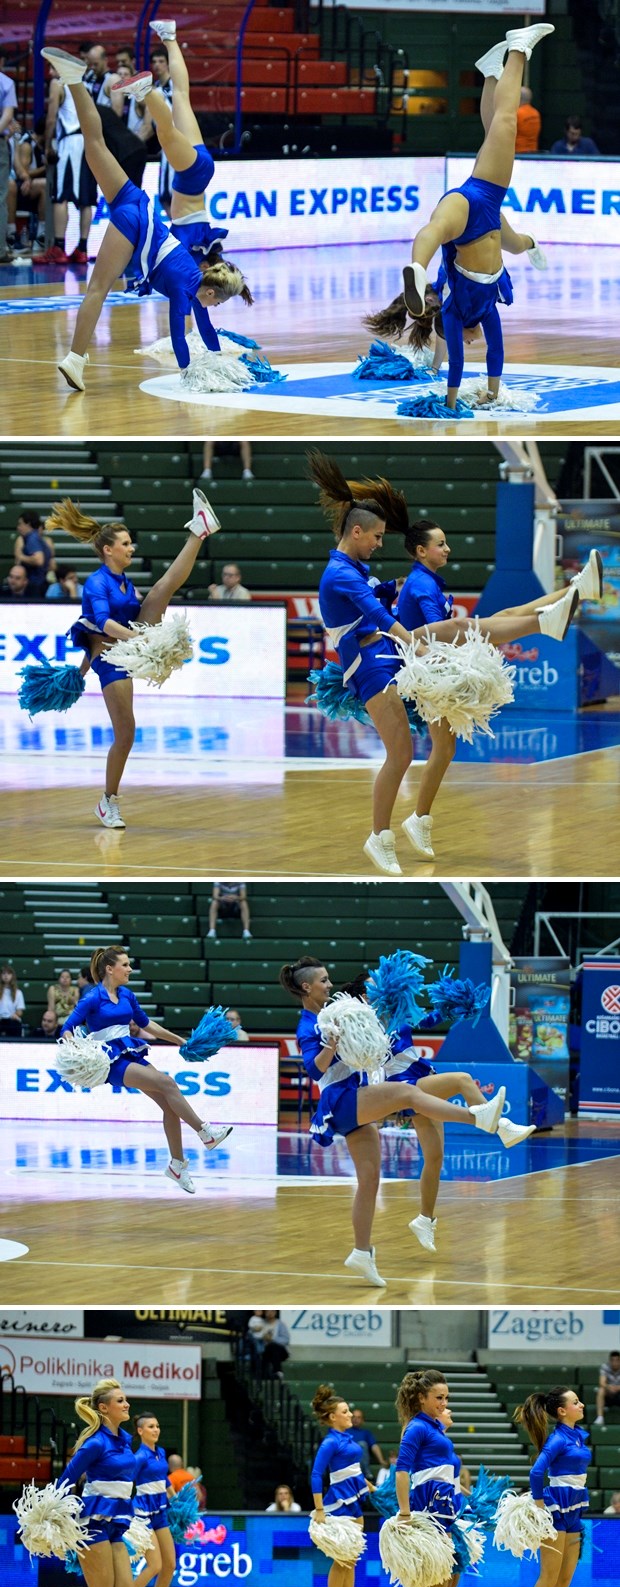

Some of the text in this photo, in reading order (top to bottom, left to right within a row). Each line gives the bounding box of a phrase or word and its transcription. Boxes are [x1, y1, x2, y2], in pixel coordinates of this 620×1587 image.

[290, 185, 420, 216] EXPRESS
[517, 973, 557, 983] ULTIMATE
[291, 1310, 383, 1337] Zagreb
[491, 1310, 584, 1341] Zagreb
[20, 1355, 200, 1380] Poliklinika Medikol
[172, 1542, 253, 1587] greb
